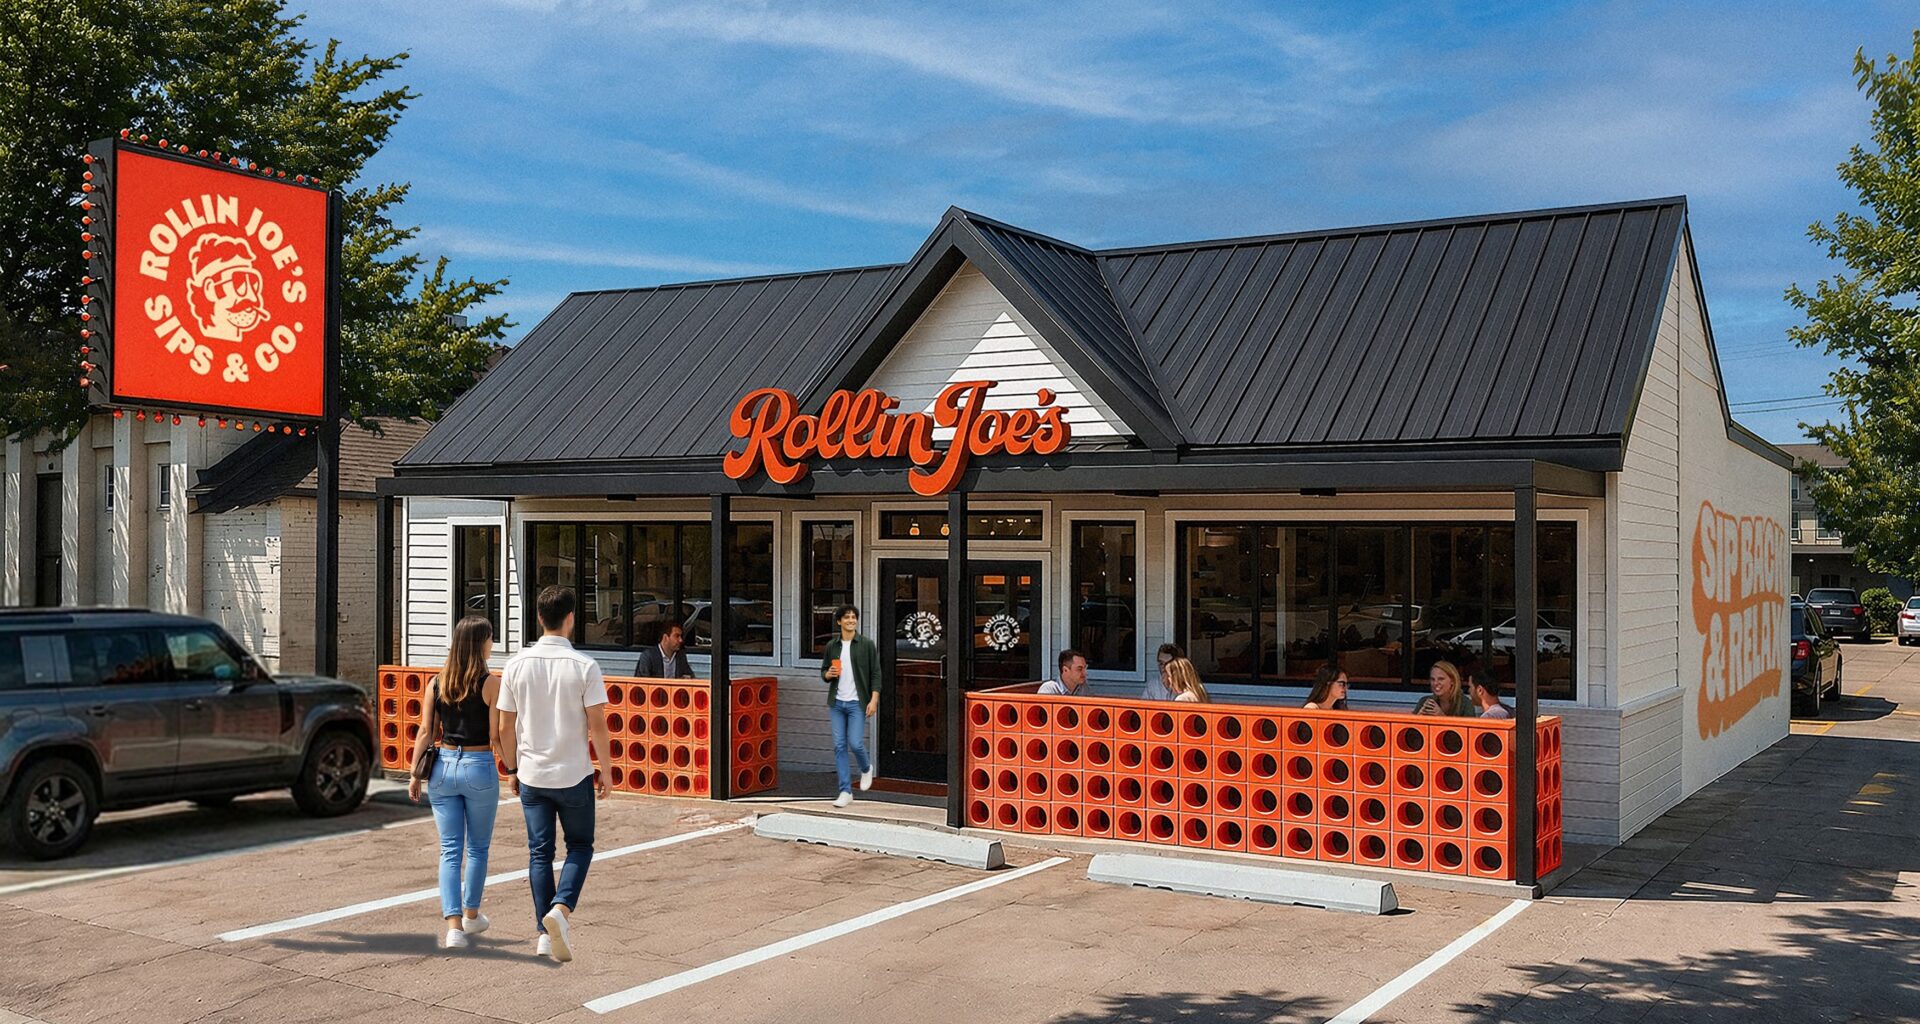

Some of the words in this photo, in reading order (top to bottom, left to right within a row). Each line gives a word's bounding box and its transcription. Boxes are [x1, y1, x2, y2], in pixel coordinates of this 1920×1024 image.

[139, 194, 239, 282] ROLLIN
[244, 207, 307, 304] JOE'S
[144, 294, 214, 375] SIPS
[222, 352, 249, 383] &
[254, 321, 304, 373] CO.
[723, 387, 942, 485] Rollin
[908, 380, 1071, 496] Joe's
[1698, 501, 1739, 603] SIP
[983, 614, 1005, 634] ROLLIN
[1705, 611, 1727, 704] &
[1728, 600, 1783, 697] RELAX
